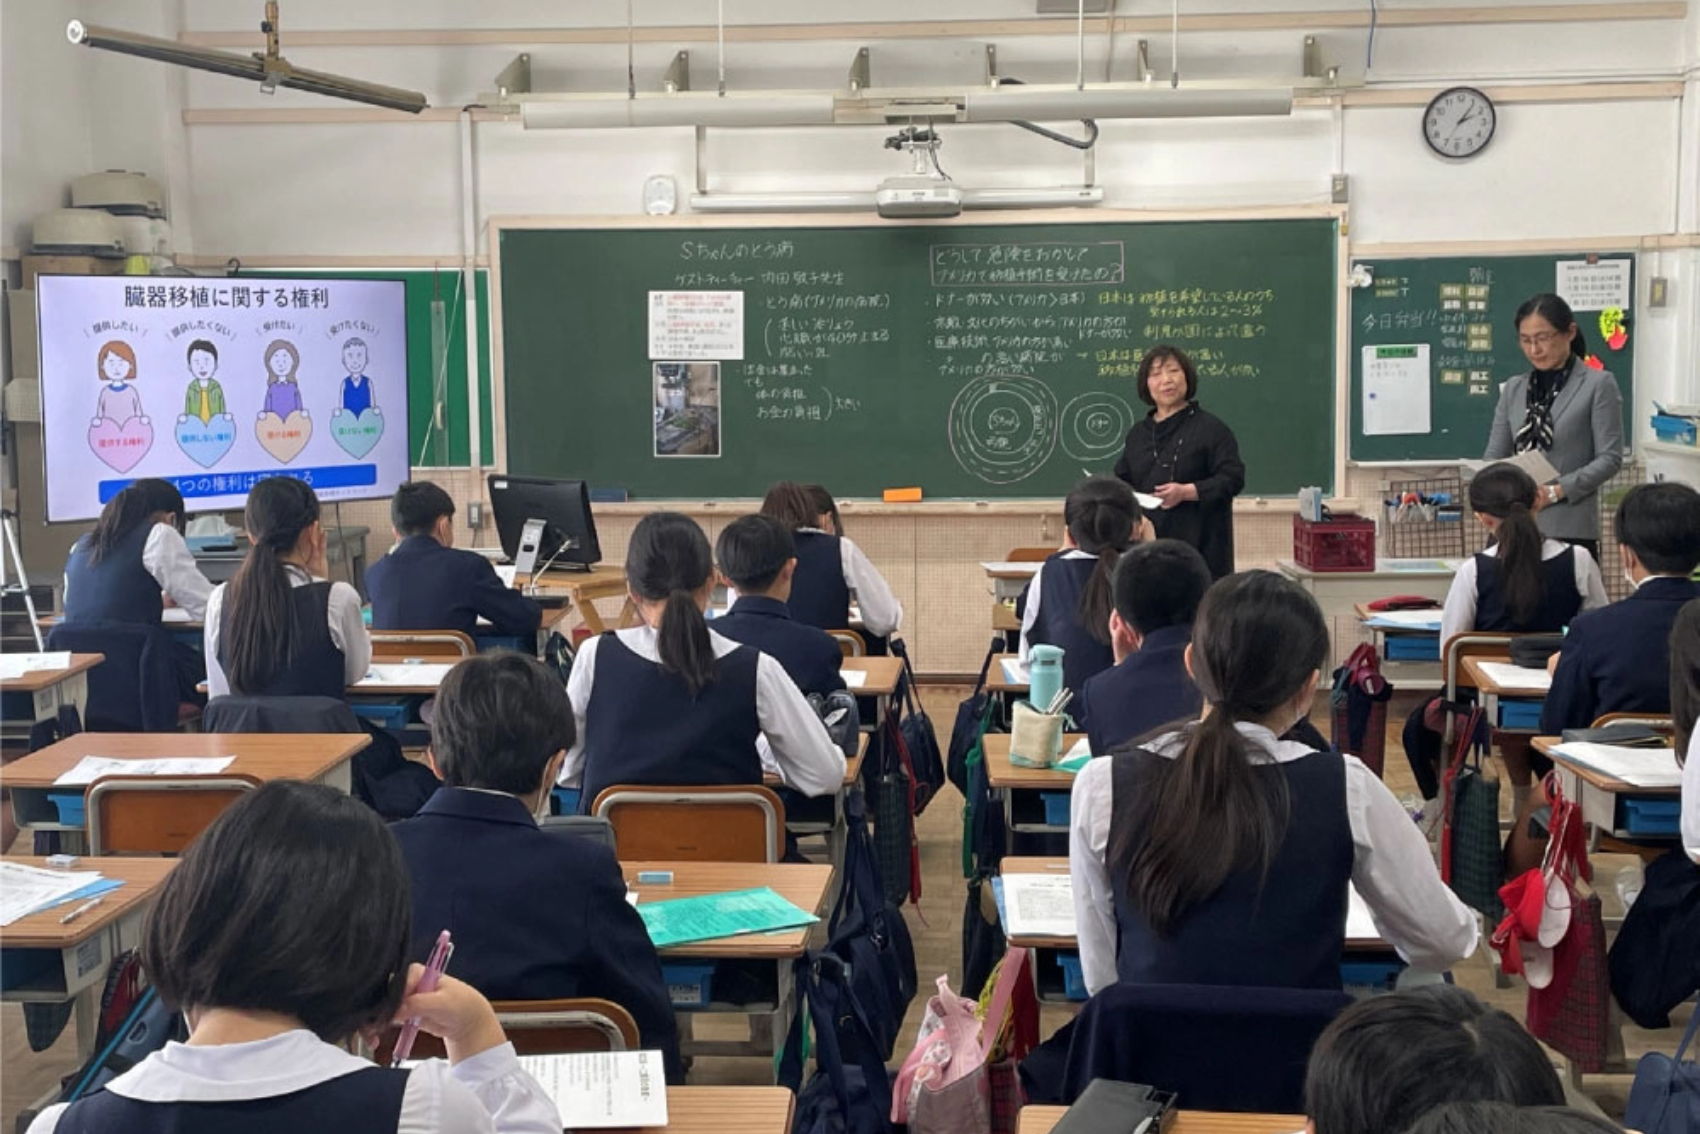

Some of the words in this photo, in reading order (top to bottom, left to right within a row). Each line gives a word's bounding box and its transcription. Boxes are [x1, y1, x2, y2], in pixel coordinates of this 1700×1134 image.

[124, 285, 329, 308] 臓器移植に関する権利
